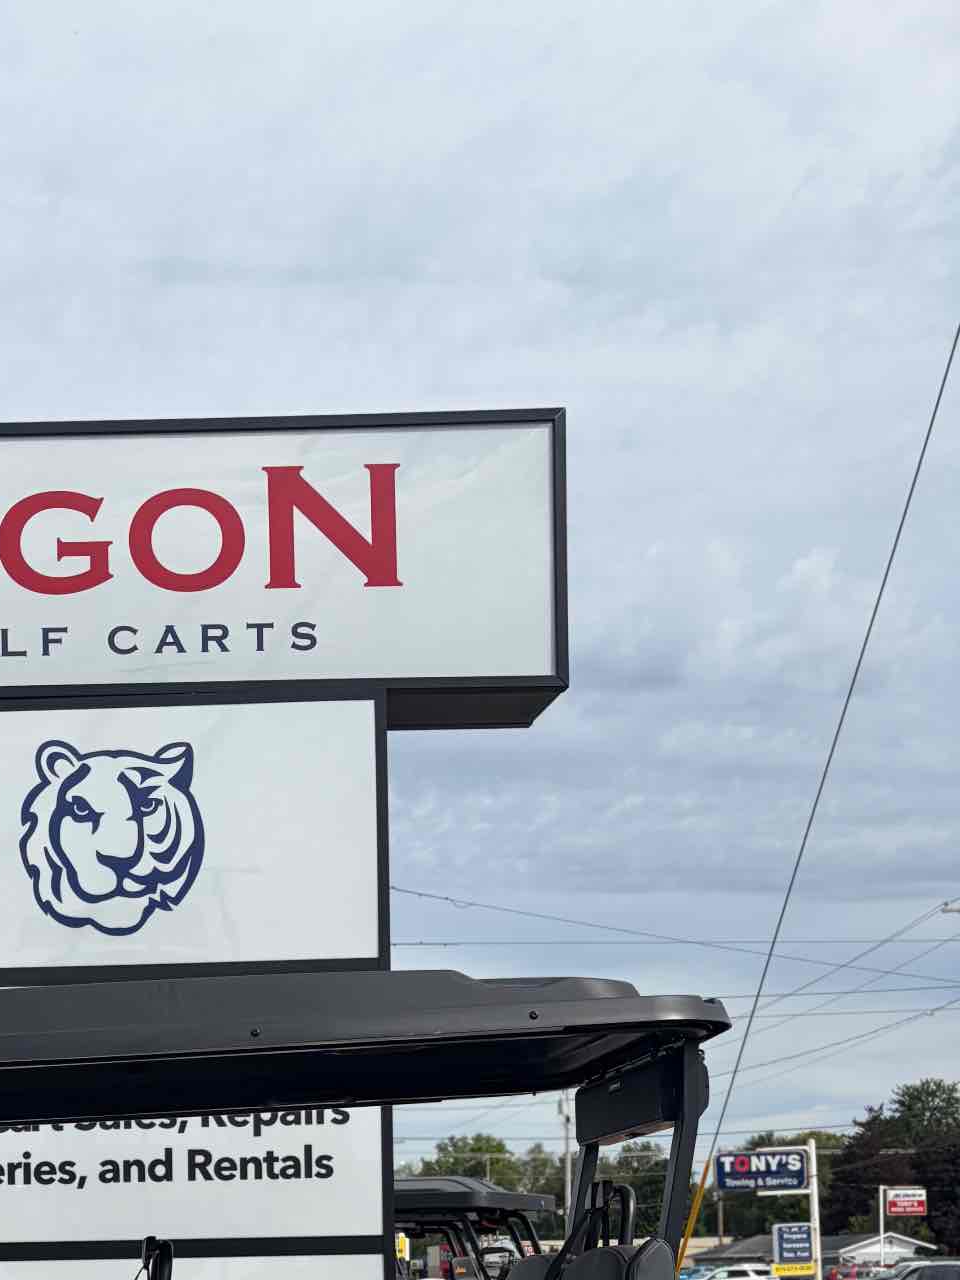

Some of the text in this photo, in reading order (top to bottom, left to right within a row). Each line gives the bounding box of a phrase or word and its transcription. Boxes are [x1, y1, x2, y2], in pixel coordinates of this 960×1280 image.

[107, 621, 317, 655] CARTS
[98, 1147, 173, 1184] and
[187, 1144, 334, 1181] Rentals
[720, 1154, 802, 1173] TONY'S
[766, 1176, 799, 1186] Service
